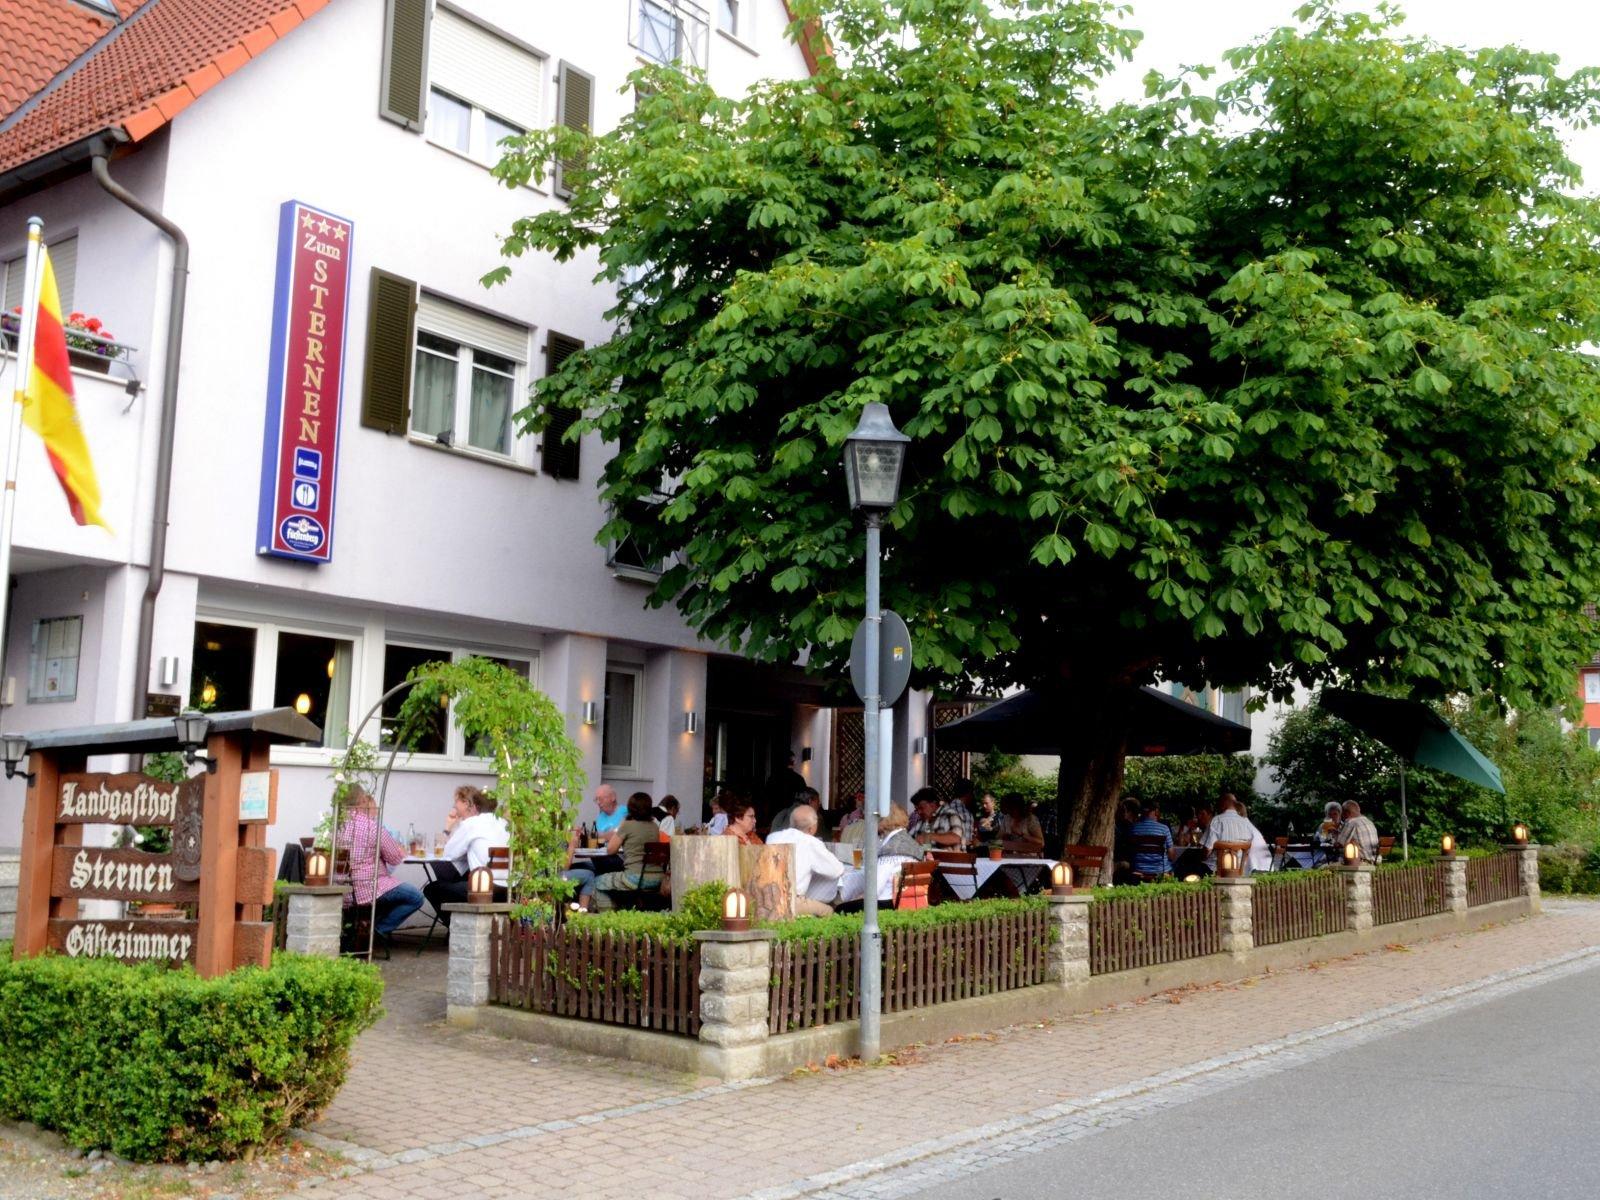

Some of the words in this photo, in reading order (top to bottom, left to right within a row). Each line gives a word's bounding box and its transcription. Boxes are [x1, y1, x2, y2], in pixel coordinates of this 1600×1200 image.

[303, 232, 341, 260] Zum
[299, 259, 329, 444] STERNEN
[70, 849, 174, 892] Sternen
